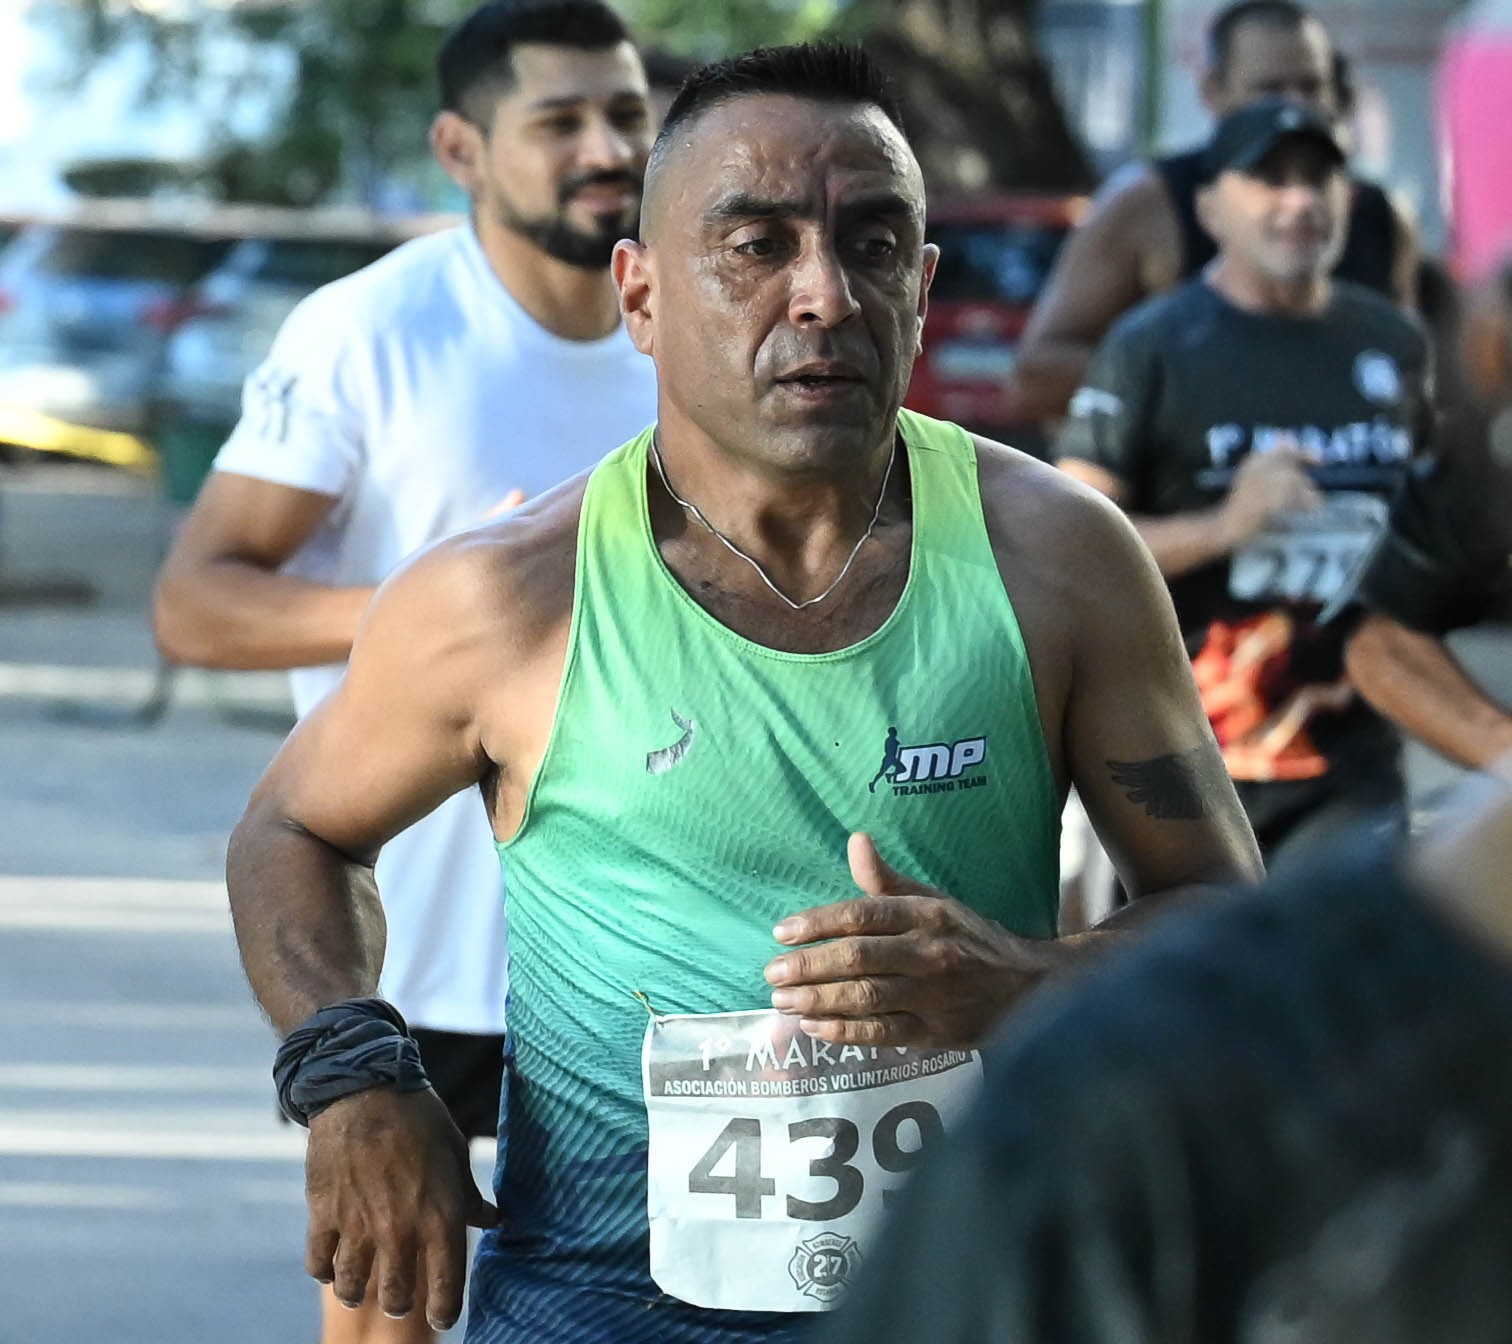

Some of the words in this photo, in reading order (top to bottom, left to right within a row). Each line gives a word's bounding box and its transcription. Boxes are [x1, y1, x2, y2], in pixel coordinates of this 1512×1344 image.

[892, 781, 955, 797] TRAINING
[958, 775, 987, 790] TEAM
[664, 1077, 747, 1096] ASOCIACIÓN
[751, 1076, 828, 1096] BOMBEROS
[831, 1060, 919, 1091] VOLUNTARIOS
[922, 1050, 966, 1074] ROSARIO
[689, 1101, 944, 1221] 439
[814, 1254, 842, 1277] 27
